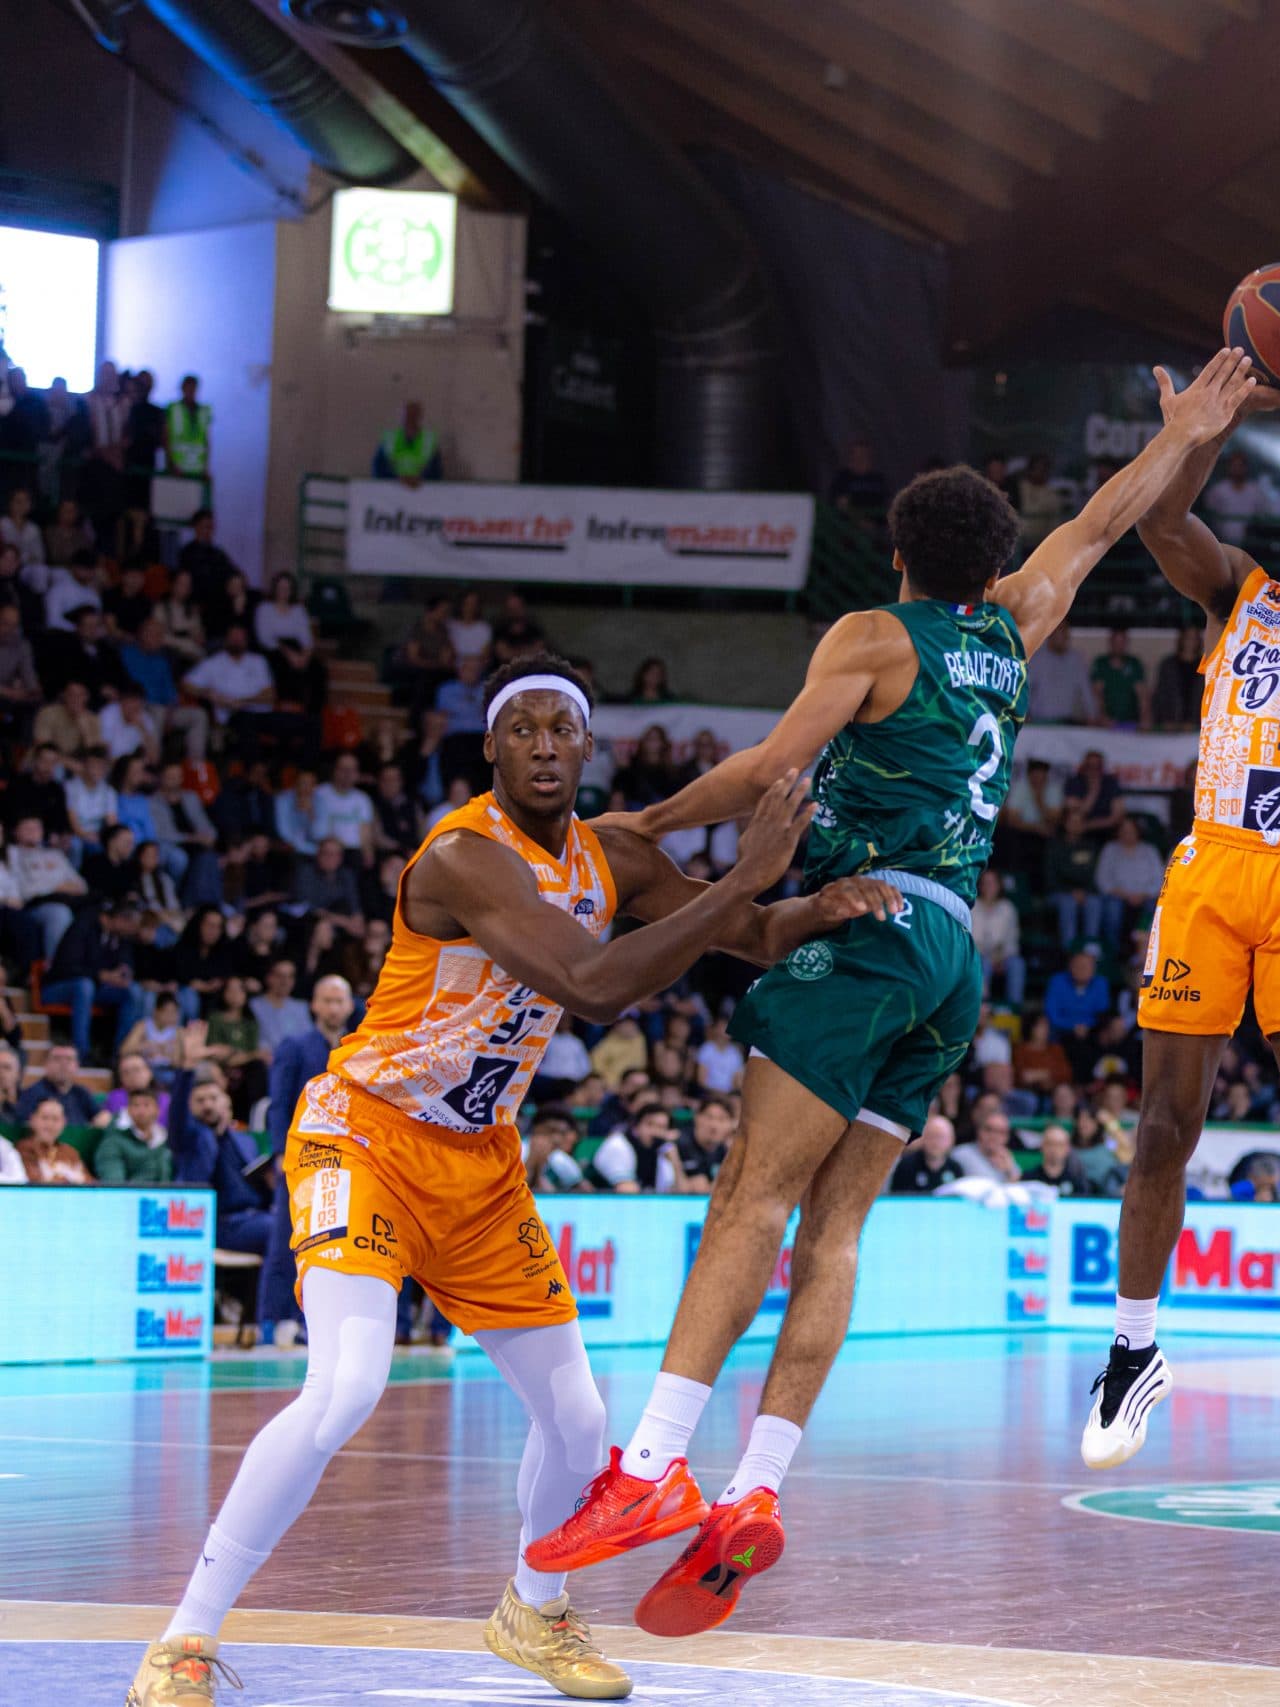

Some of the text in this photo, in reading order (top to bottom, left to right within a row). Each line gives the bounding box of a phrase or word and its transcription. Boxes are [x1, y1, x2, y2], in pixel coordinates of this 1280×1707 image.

[943, 651, 1020, 696] BEAUFORT
[967, 713, 1003, 821] 2
[893, 898, 913, 930] 2
[1149, 985, 1201, 1002] Clovis
[140, 1197, 205, 1233] BigMat
[138, 1253, 204, 1288] BigMat
[136, 1308, 203, 1344] BigMat
